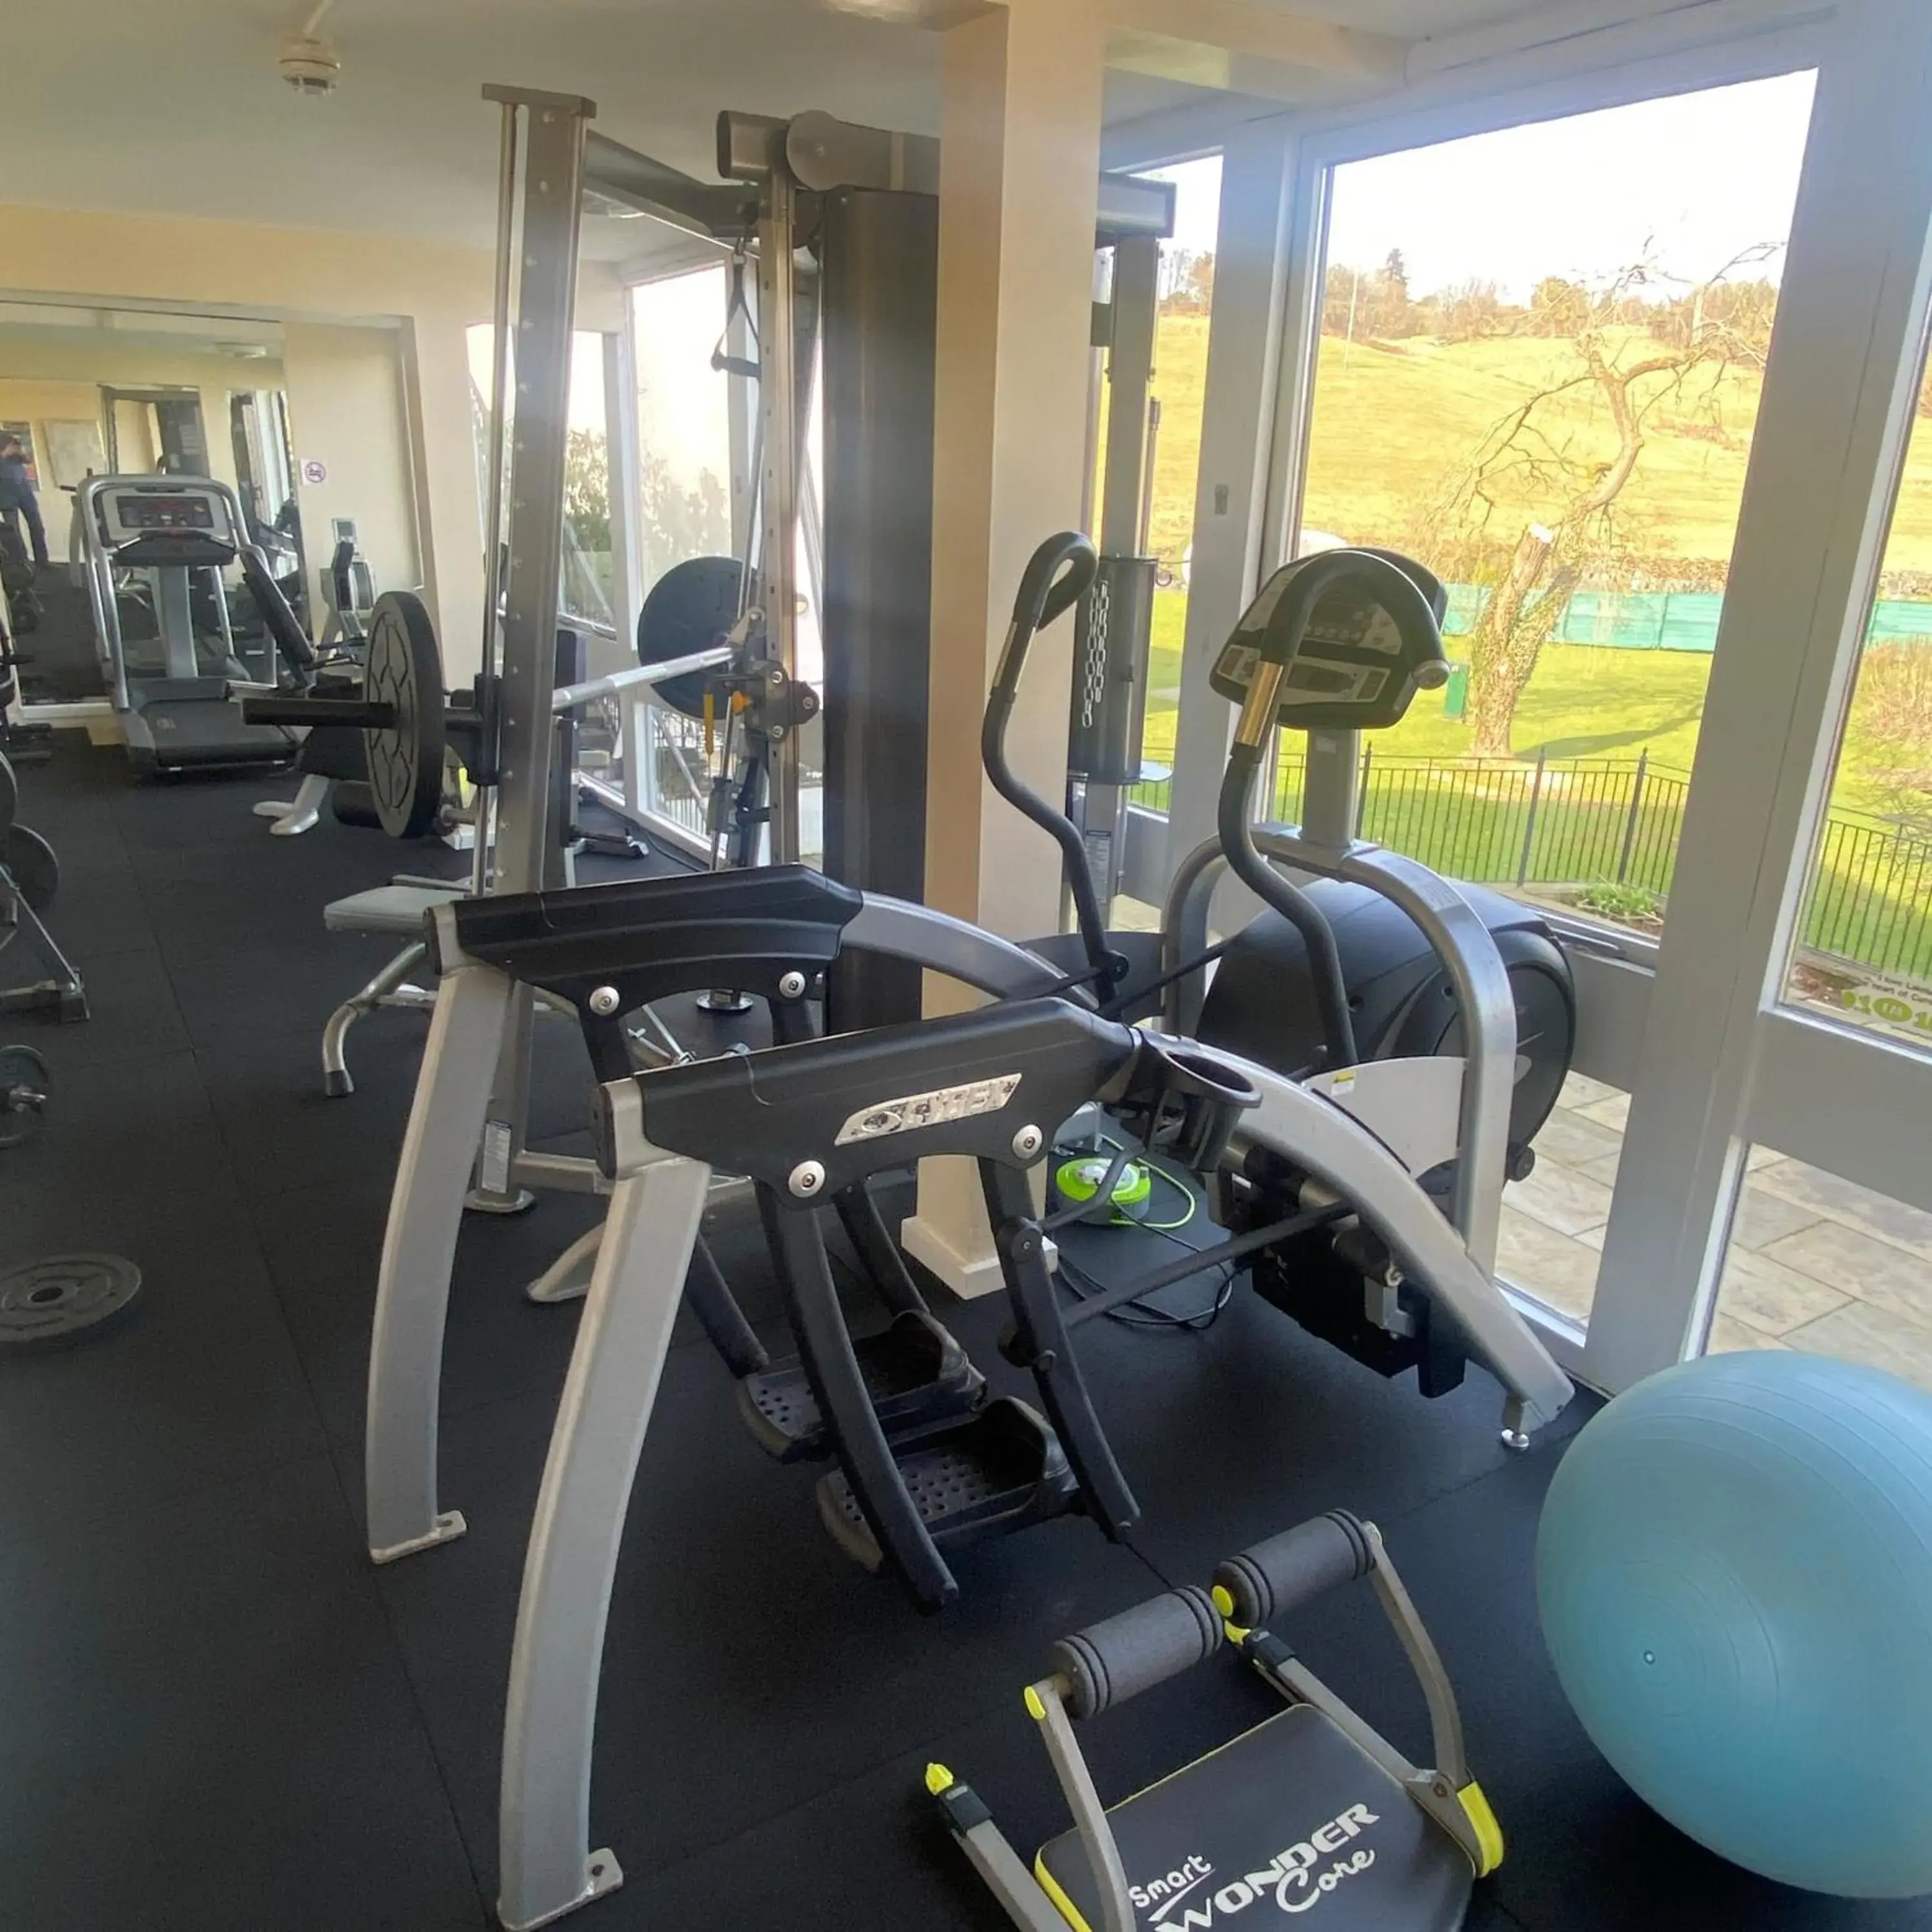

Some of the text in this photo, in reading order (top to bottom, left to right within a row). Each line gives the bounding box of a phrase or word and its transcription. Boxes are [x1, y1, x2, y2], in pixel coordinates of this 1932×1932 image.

[1128, 1855, 1212, 1908] Smart
[1154, 1803, 1381, 1932] WONDER
[1276, 1849, 1376, 1913] Core
